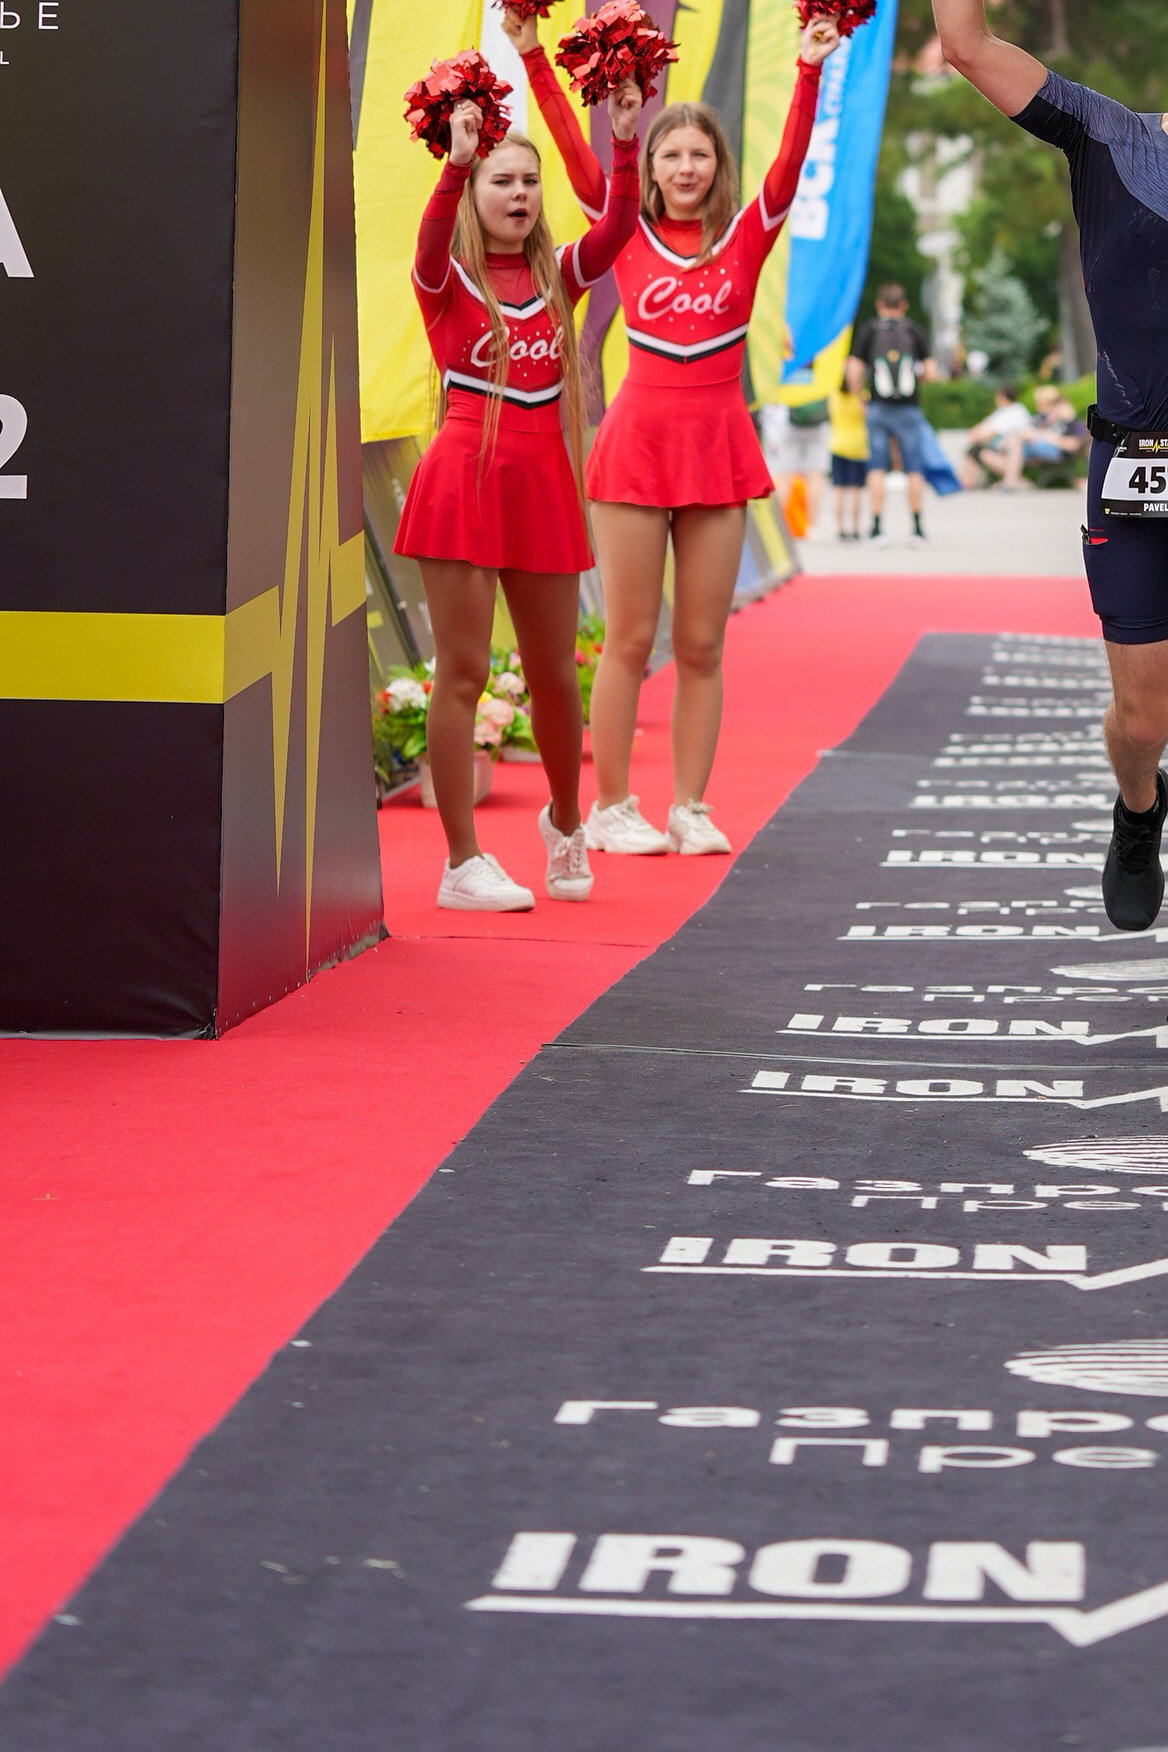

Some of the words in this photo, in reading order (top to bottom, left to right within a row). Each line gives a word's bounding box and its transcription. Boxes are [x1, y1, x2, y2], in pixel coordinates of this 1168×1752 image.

[638, 275, 733, 320] Cool
[470, 324, 564, 368] Cool
[1139, 439, 1154, 447] IRON
[1143, 502, 1168, 512] PAVEL
[847, 924, 1100, 937] IRON
[787, 1013, 1090, 1036] IRON
[751, 1070, 1084, 1097] IRON
[660, 1236, 1088, 1272] IRON
[491, 1530, 1086, 1602] IRON
